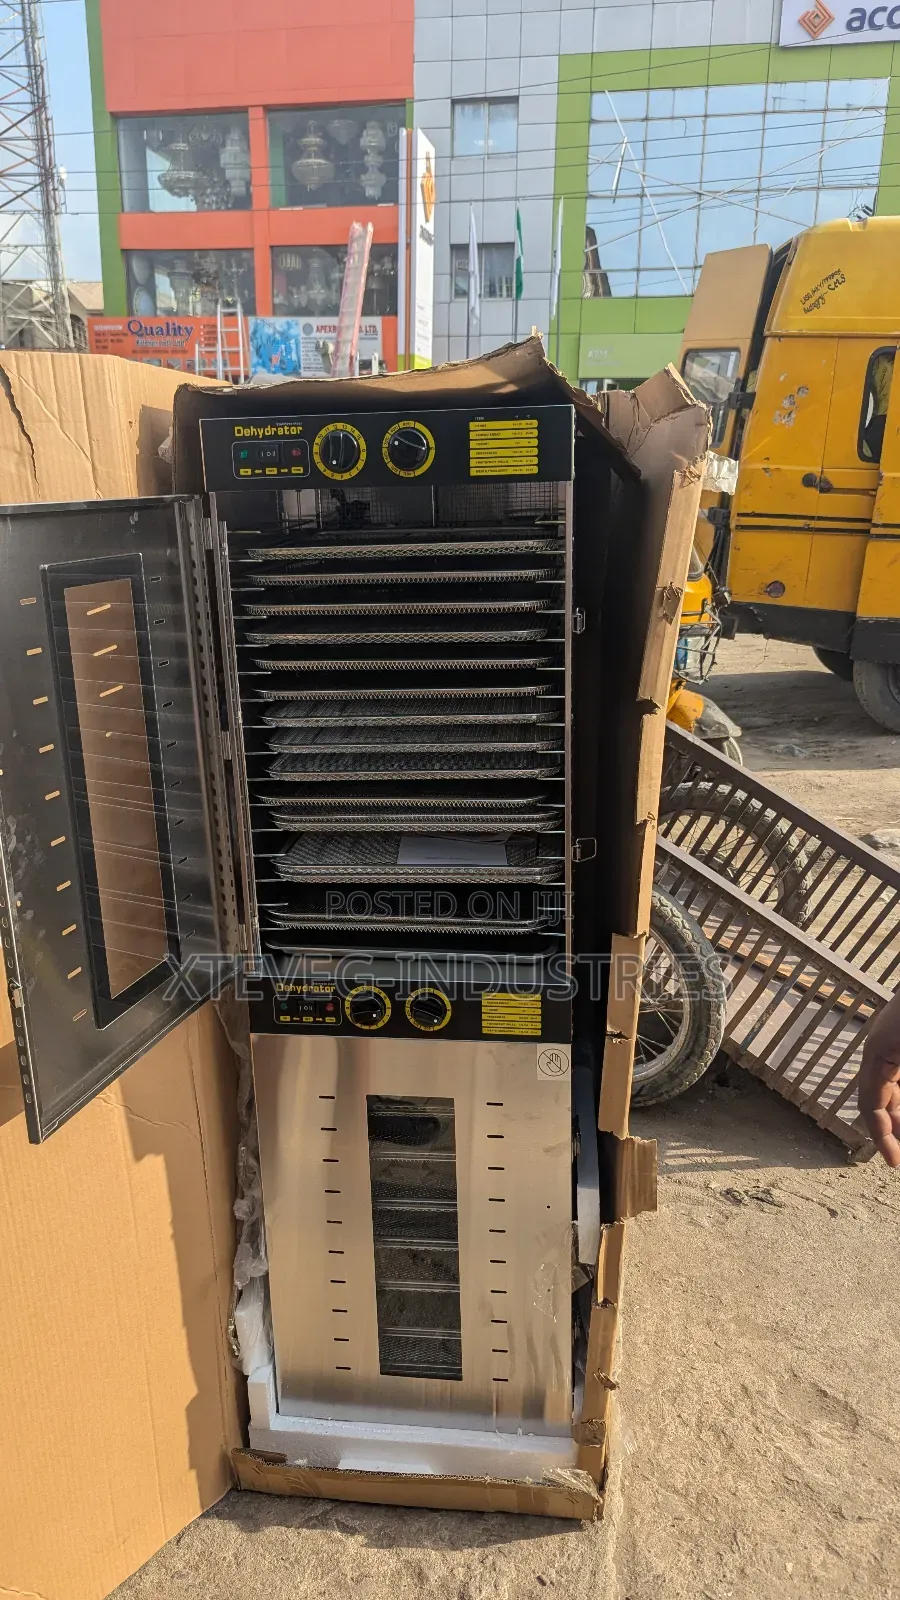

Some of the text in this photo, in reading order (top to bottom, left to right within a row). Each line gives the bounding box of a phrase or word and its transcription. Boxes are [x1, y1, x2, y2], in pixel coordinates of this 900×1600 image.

[127, 319, 194, 341] Quality
[234, 425, 303, 439] Dehydrator
[275, 982, 336, 994] Dehydrator
